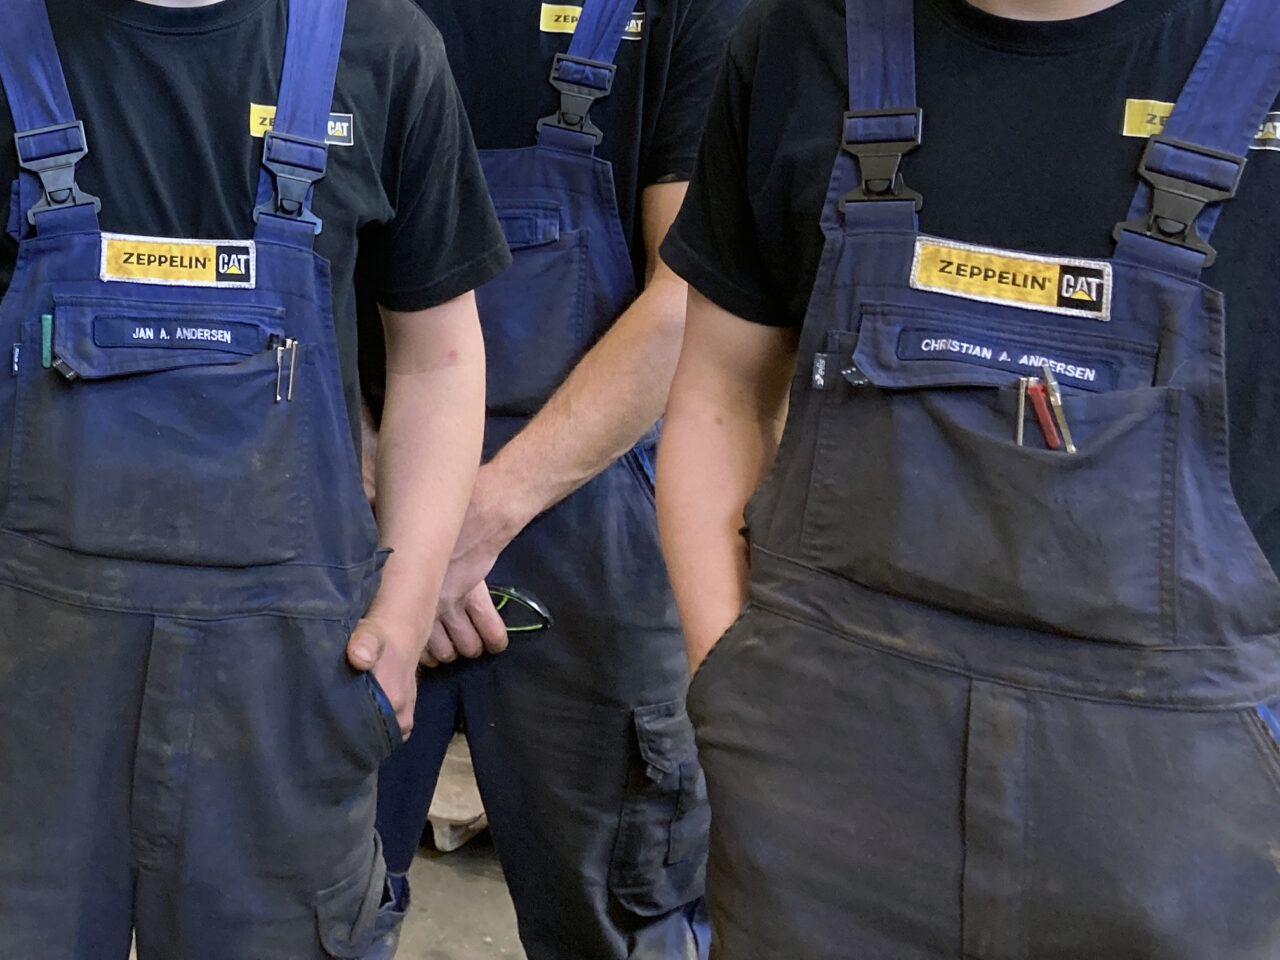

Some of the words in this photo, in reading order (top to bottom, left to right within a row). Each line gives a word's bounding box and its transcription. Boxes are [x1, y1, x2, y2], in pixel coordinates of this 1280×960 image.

[327, 120, 349, 136] CAT
[122, 251, 207, 269] ZEPPELIN
[218, 253, 249, 274] CAT
[938, 259, 1048, 291] ZEPPELIN
[1061, 274, 1103, 302] CAT
[132, 327, 153, 339] JAN
[160, 328, 170, 340] A.
[176, 327, 231, 343] ANDERSEN
[921, 338, 993, 360] CHRISTIAN
[998, 351, 1011, 362] A.
[1018, 354, 1096, 382] ANDERSEN
